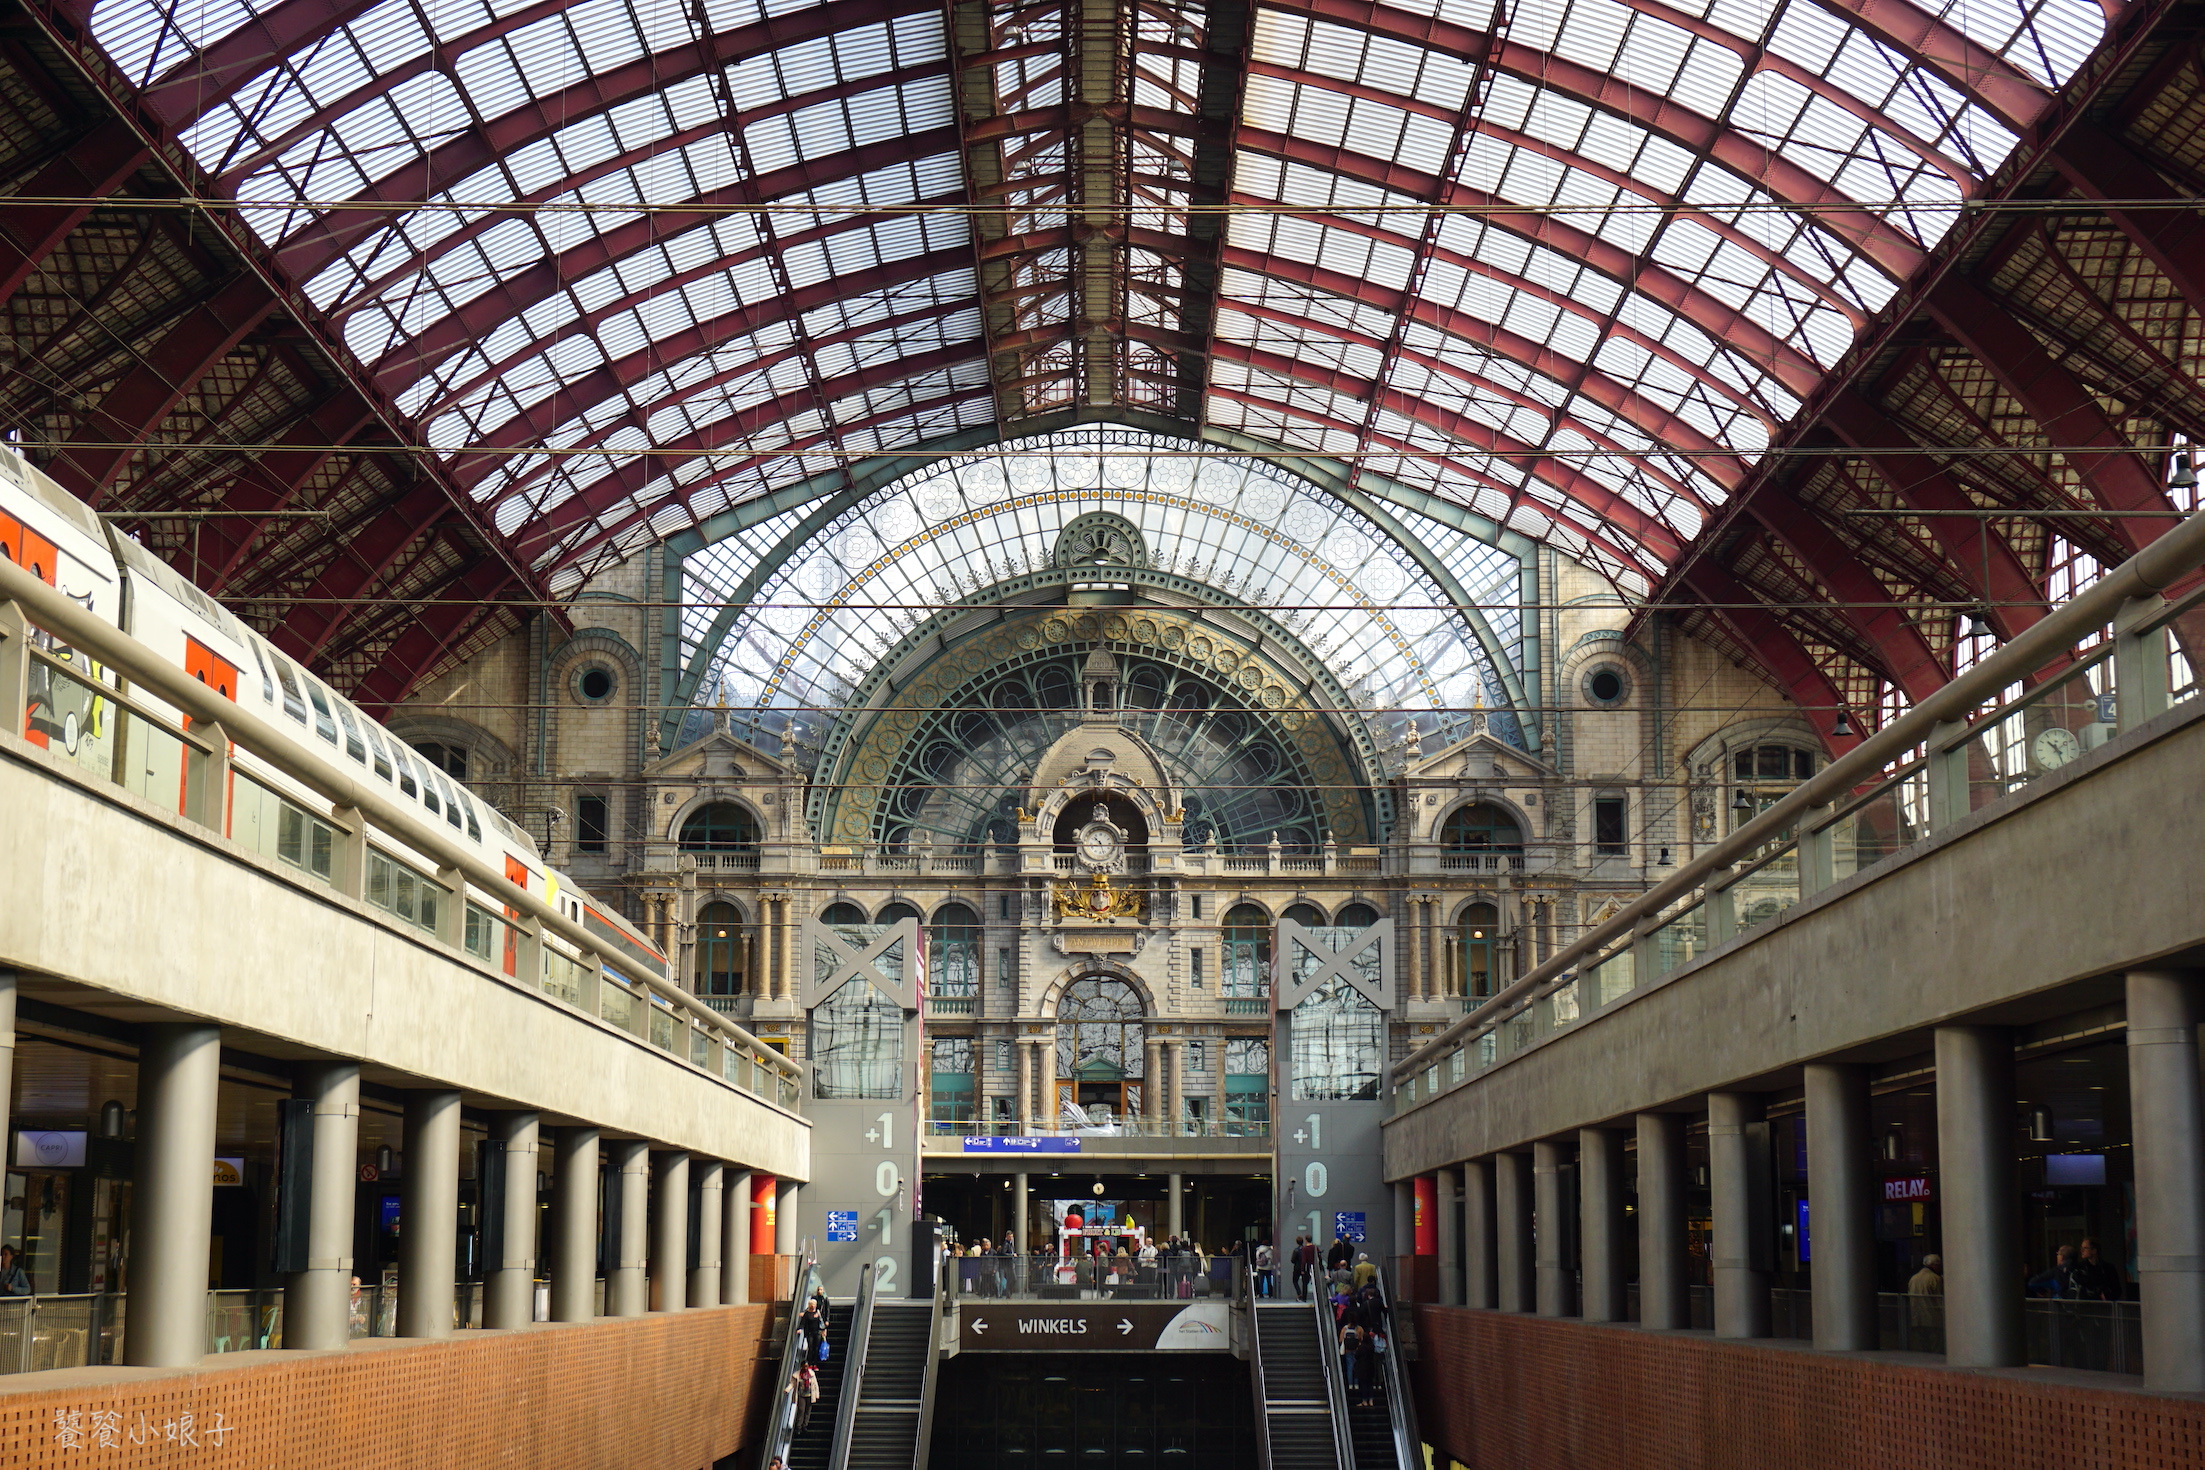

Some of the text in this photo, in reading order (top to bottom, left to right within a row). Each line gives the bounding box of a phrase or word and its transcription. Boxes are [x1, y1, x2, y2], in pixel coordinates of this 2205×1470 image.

[2107, 702, 2117, 717] 4
[1070, 937, 1129, 947] ANTWERPEN
[876, 1160, 899, 1197] 0
[1305, 1161, 1328, 1198] 0
[1018, 1319, 1087, 1334] WINKELS
